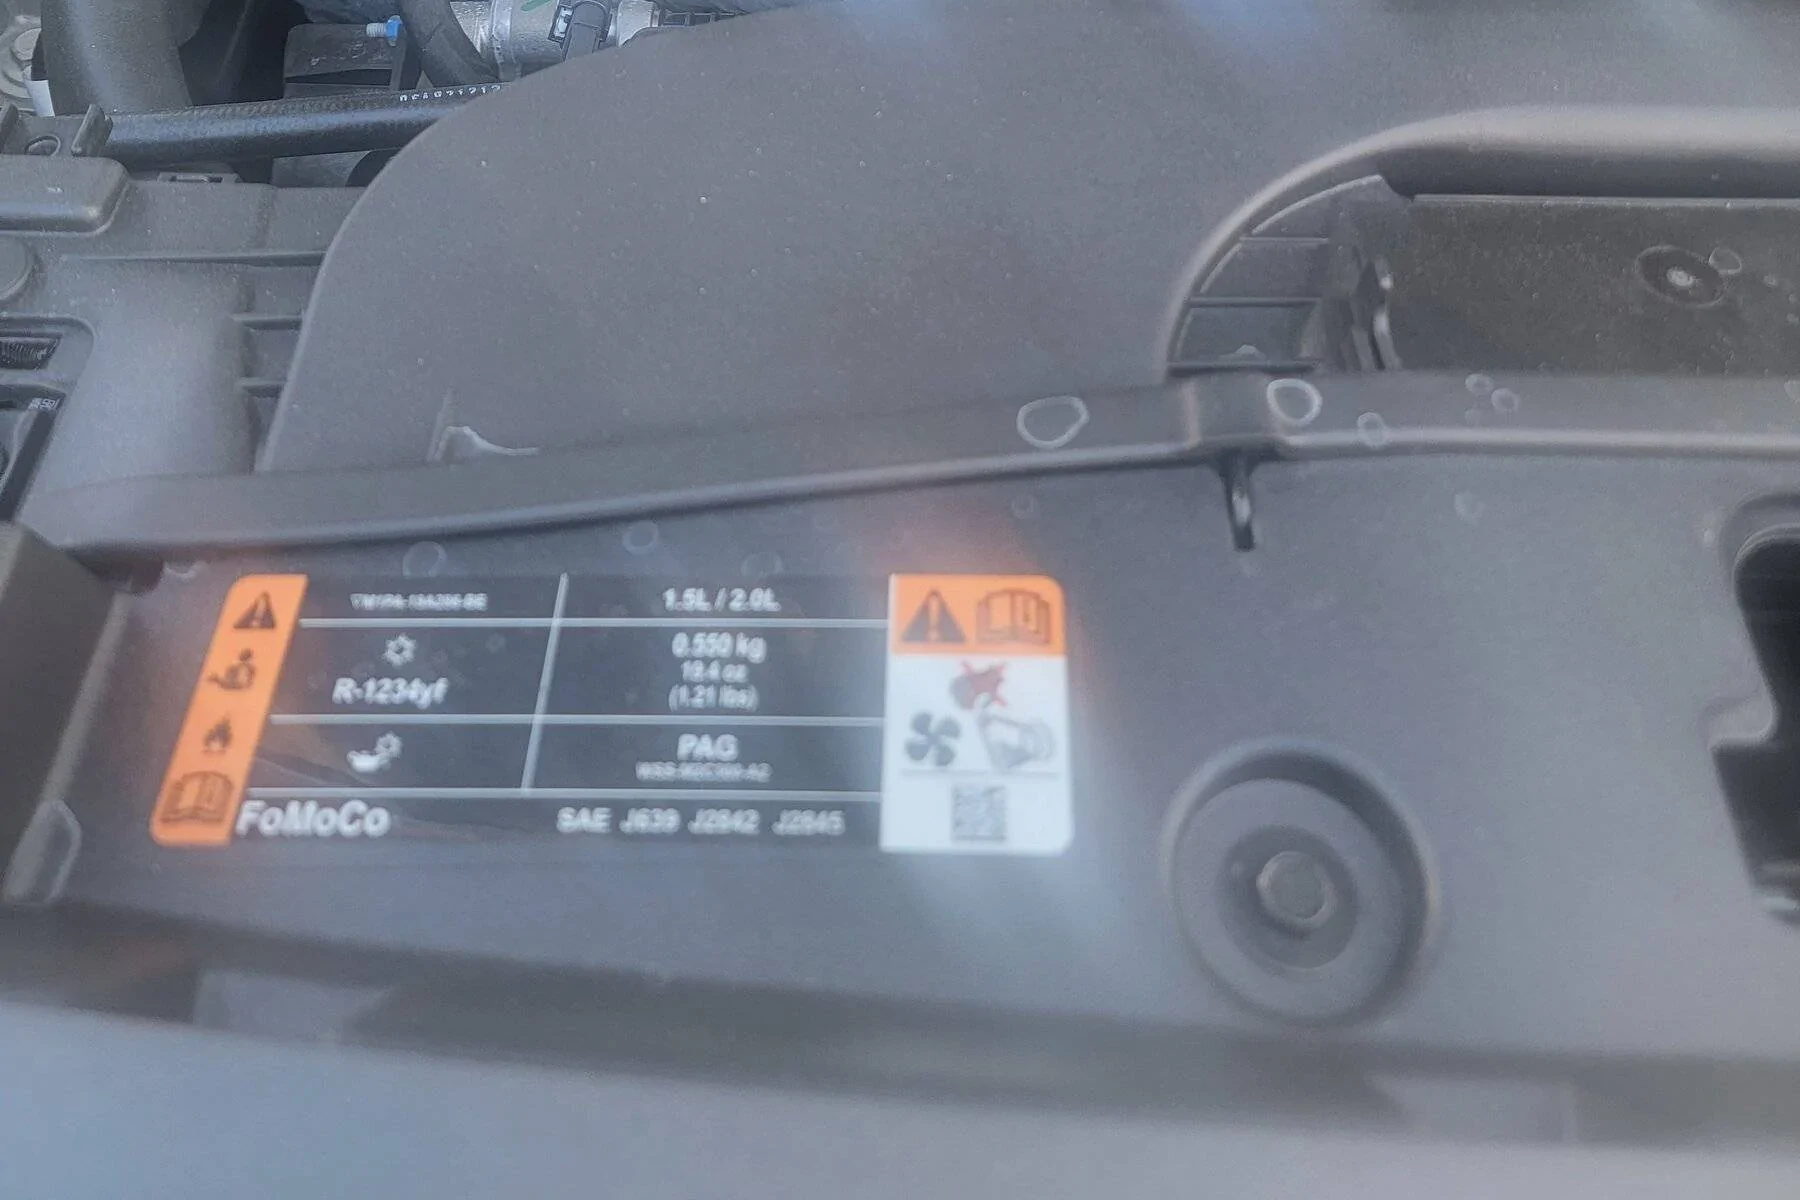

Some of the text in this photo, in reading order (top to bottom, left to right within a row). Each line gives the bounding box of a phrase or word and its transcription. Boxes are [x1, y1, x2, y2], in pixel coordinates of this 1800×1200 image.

[672, 632, 767, 664] 0.550 kg
[332, 677, 449, 709] R-1234yf
[677, 734, 740, 761] PAG
[235, 800, 391, 838] FoMoCo
[556, 807, 612, 833] SAE
